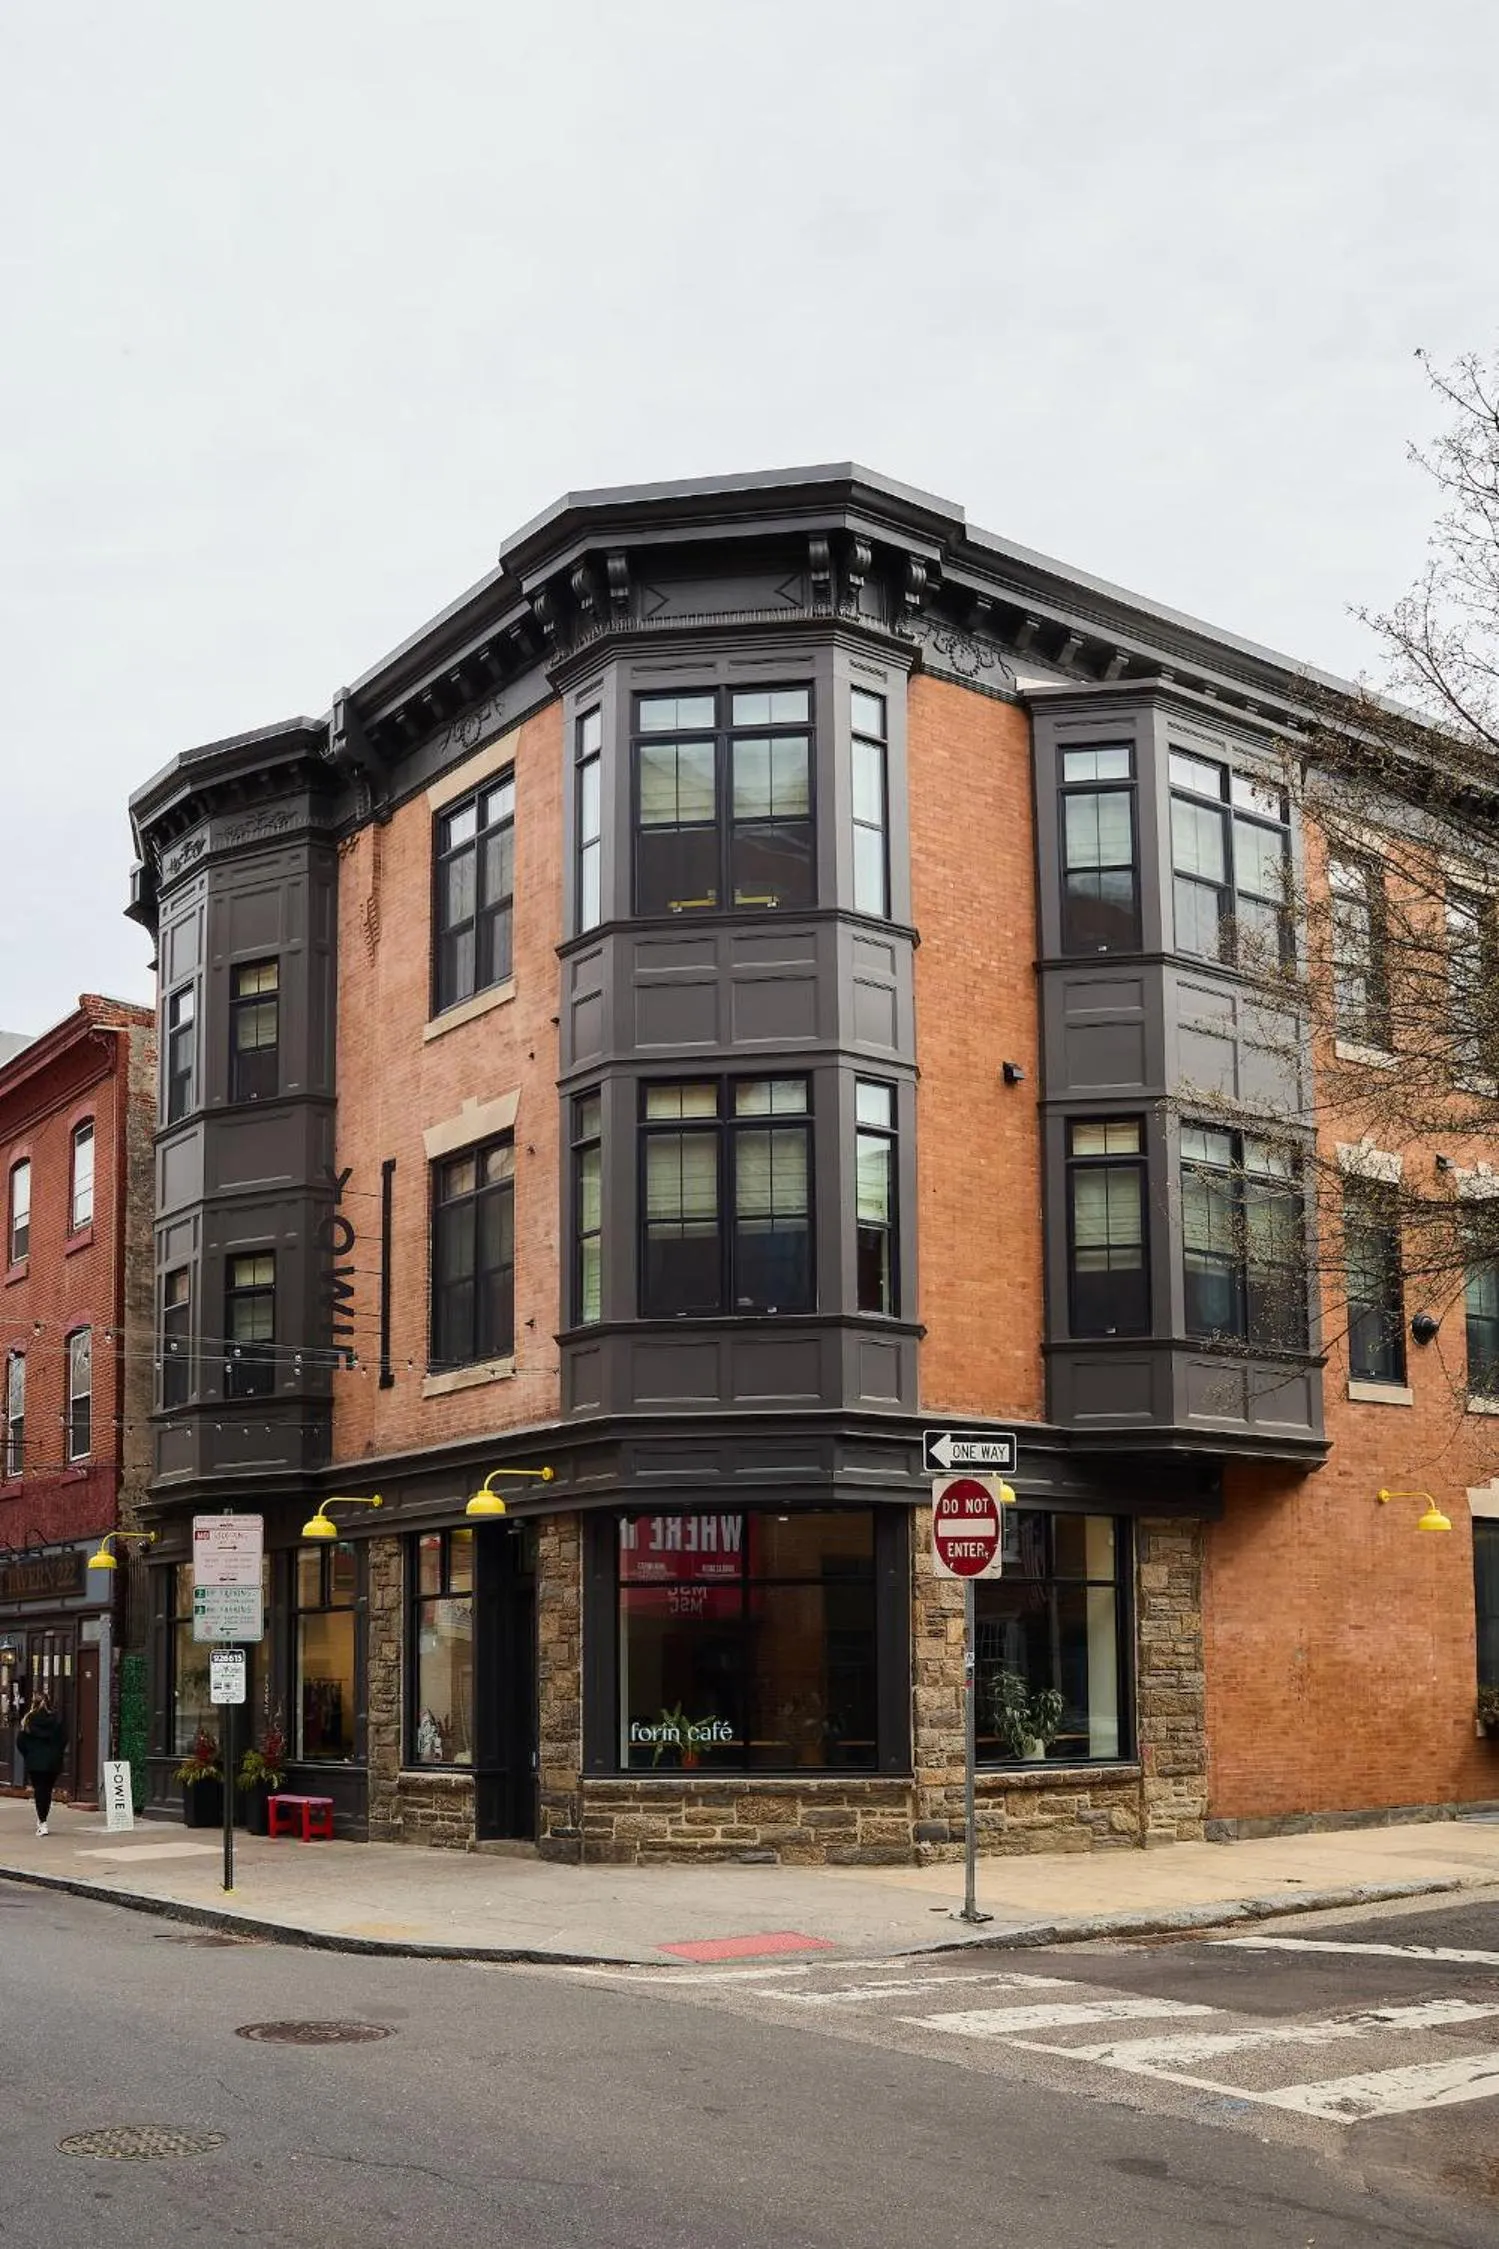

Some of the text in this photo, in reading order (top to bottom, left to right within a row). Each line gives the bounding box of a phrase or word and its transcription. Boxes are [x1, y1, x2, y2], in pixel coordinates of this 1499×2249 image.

[318, 1166, 355, 1370] YOWIE
[952, 1444, 1006, 1460] ONE WAY
[942, 1498, 989, 1514] DO NOT
[947, 1542, 985, 1557] ENTER
[631, 1720, 733, 1742] forin café
[113, 1763, 126, 1809] YOWIE
